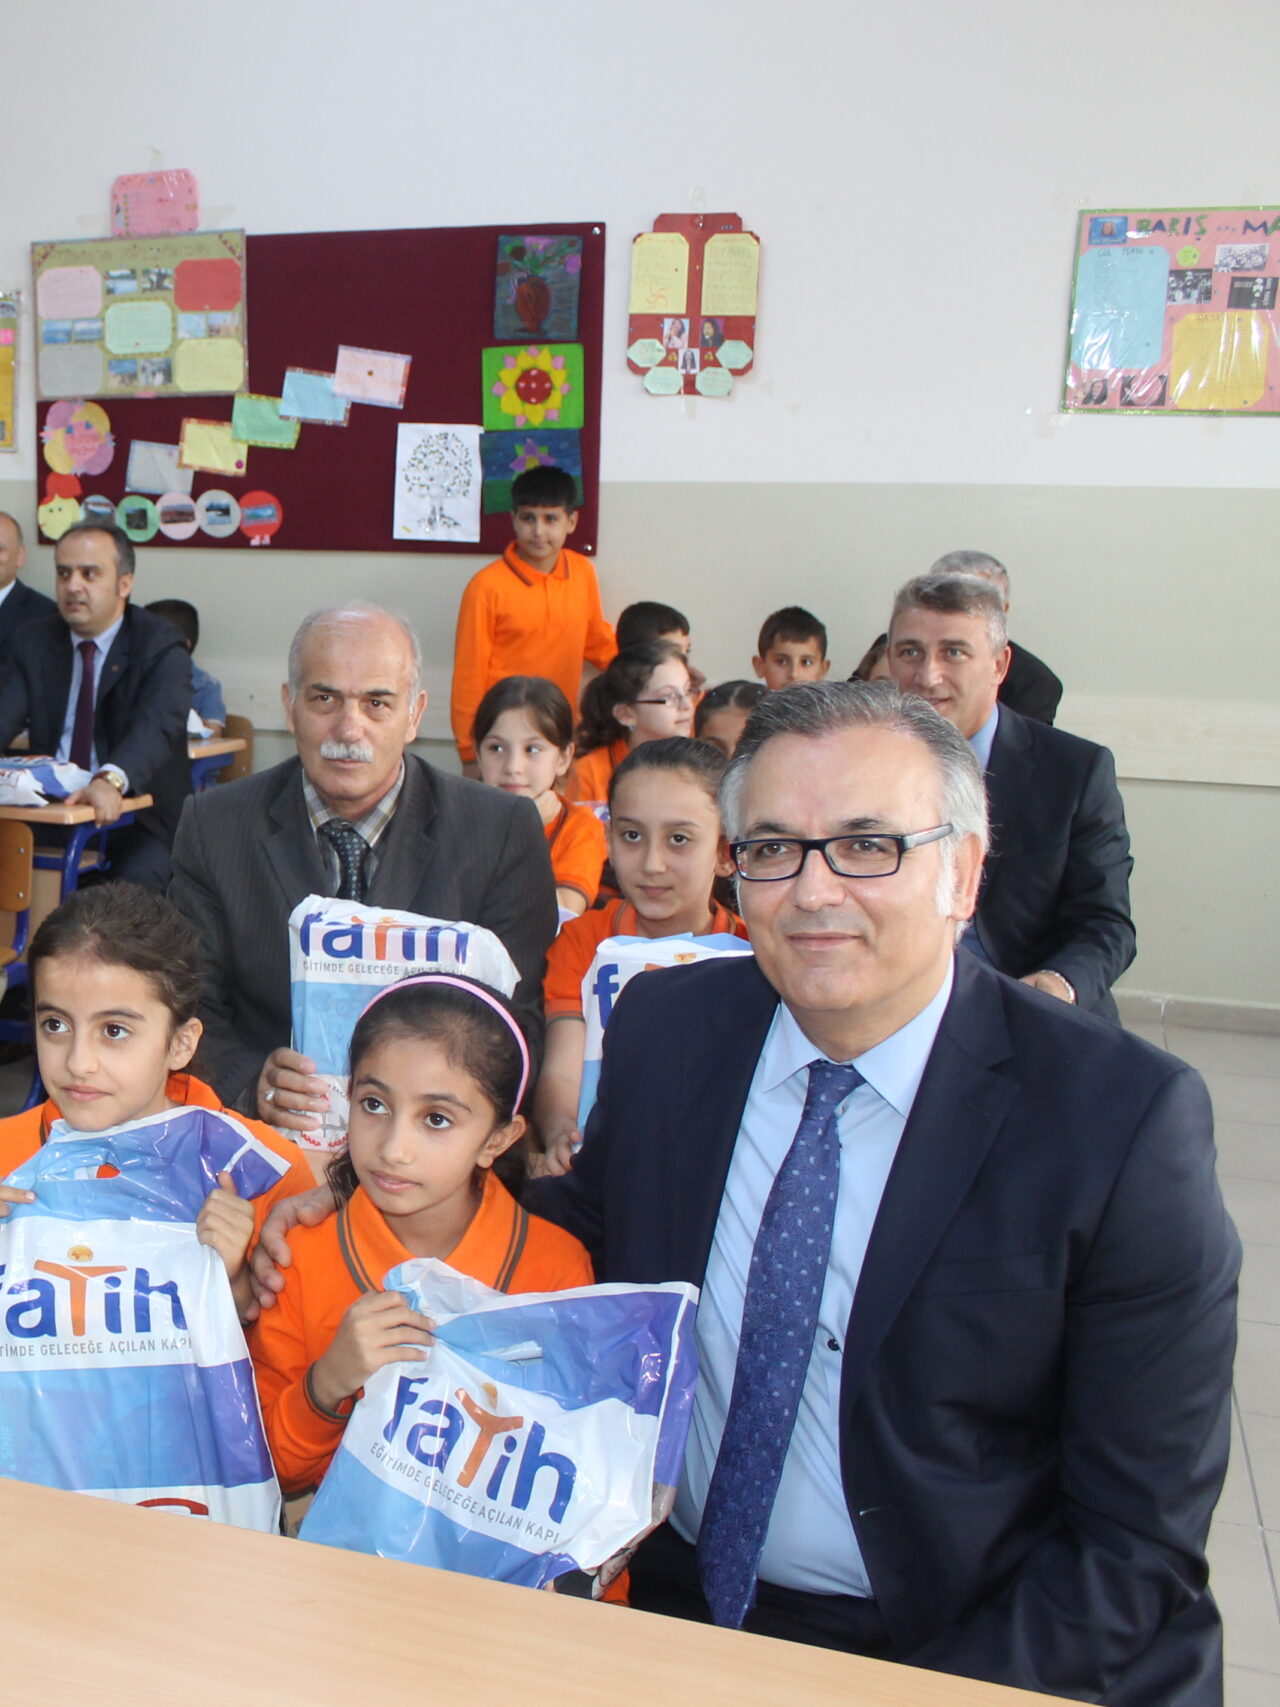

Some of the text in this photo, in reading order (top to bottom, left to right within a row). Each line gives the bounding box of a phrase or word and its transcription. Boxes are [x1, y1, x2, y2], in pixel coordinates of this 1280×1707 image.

[348, 963, 400, 976] GELECEĞE
[40, 1340, 104, 1356] GELECEĞE
[109, 1340, 156, 1356] AÇILAN
[370, 1442, 421, 1482] EĞİTİMDE
[478, 1506, 524, 1530] AÇILAN
[525, 1521, 560, 1544] KAPI
